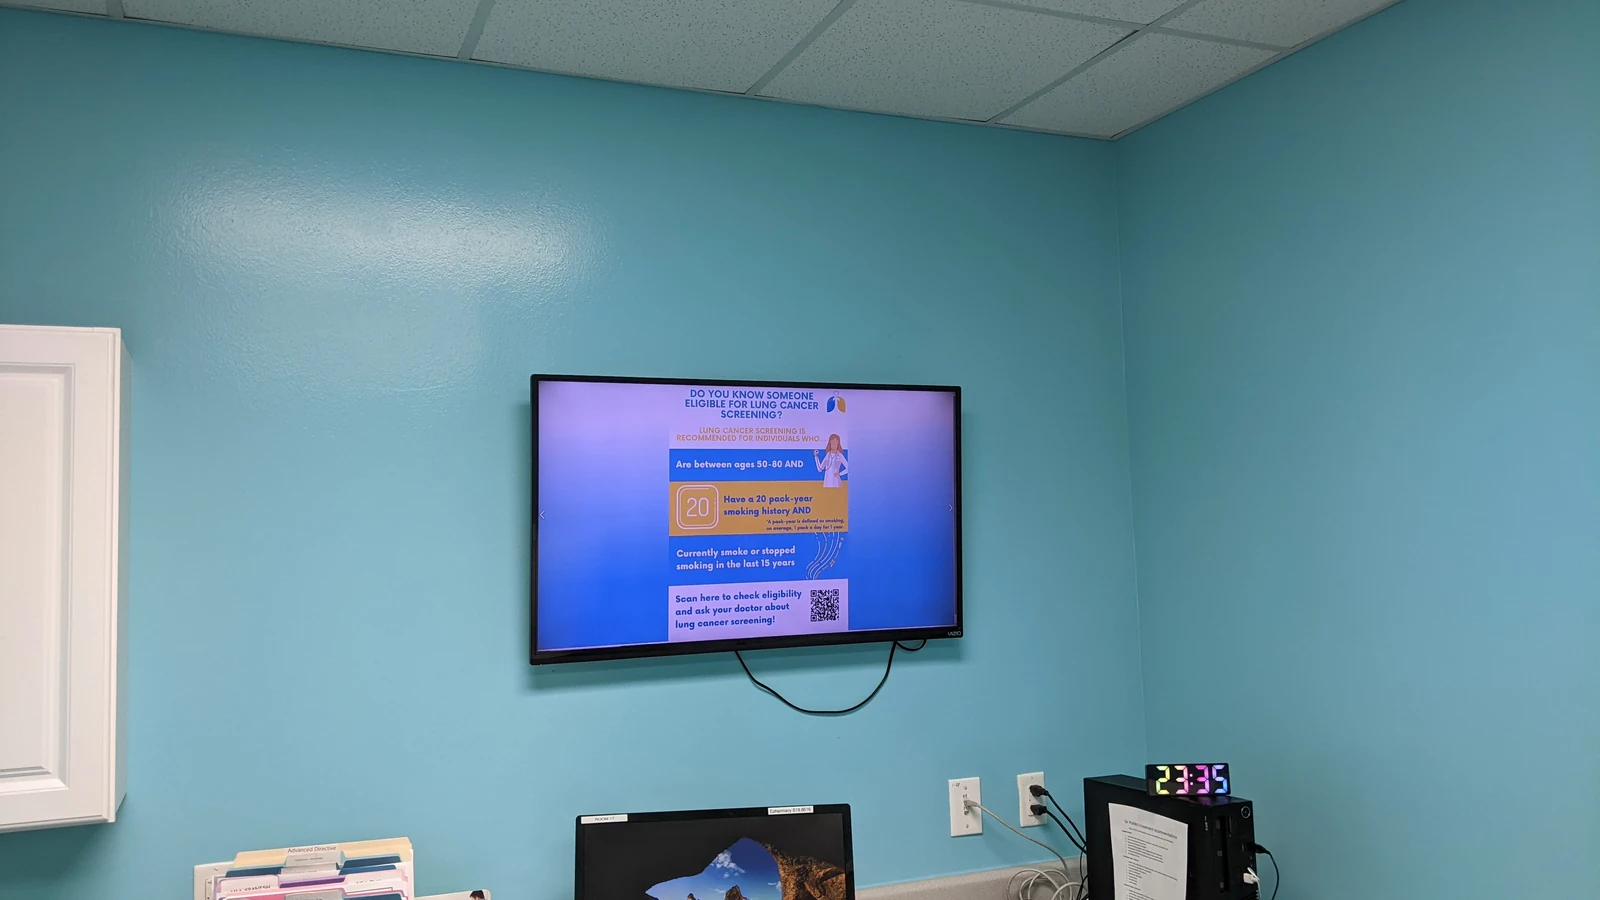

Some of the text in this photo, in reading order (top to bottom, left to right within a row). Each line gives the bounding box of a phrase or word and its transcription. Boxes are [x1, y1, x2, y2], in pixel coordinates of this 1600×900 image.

[732, 391, 764, 399] KNOW
[767, 392, 813, 400] SOMEONE
[685, 399, 818, 410] ELIGIBLE FOR LUNG CANCER
[721, 410, 782, 419] SCREENING?
[694, 460, 732, 468] between
[734, 461, 754, 470] ages
[769, 495, 812, 504] pack-year
[687, 498, 709, 516] 20
[724, 507, 759, 517] smoking
[762, 507, 790, 516] history
[676, 548, 719, 558] Currently
[720, 547, 748, 556] smoke
[762, 546, 795, 556] stopped
[676, 561, 713, 571] smoking
[727, 560, 741, 568] the
[772, 560, 795, 568] years
[733, 592, 760, 600] check
[762, 590, 802, 600] eligibility
[676, 603, 789, 616] and ask your doctor about
[675, 620, 694, 630] lung
[731, 616, 775, 626] screening!
[1156, 764, 1228, 794] 23:35
